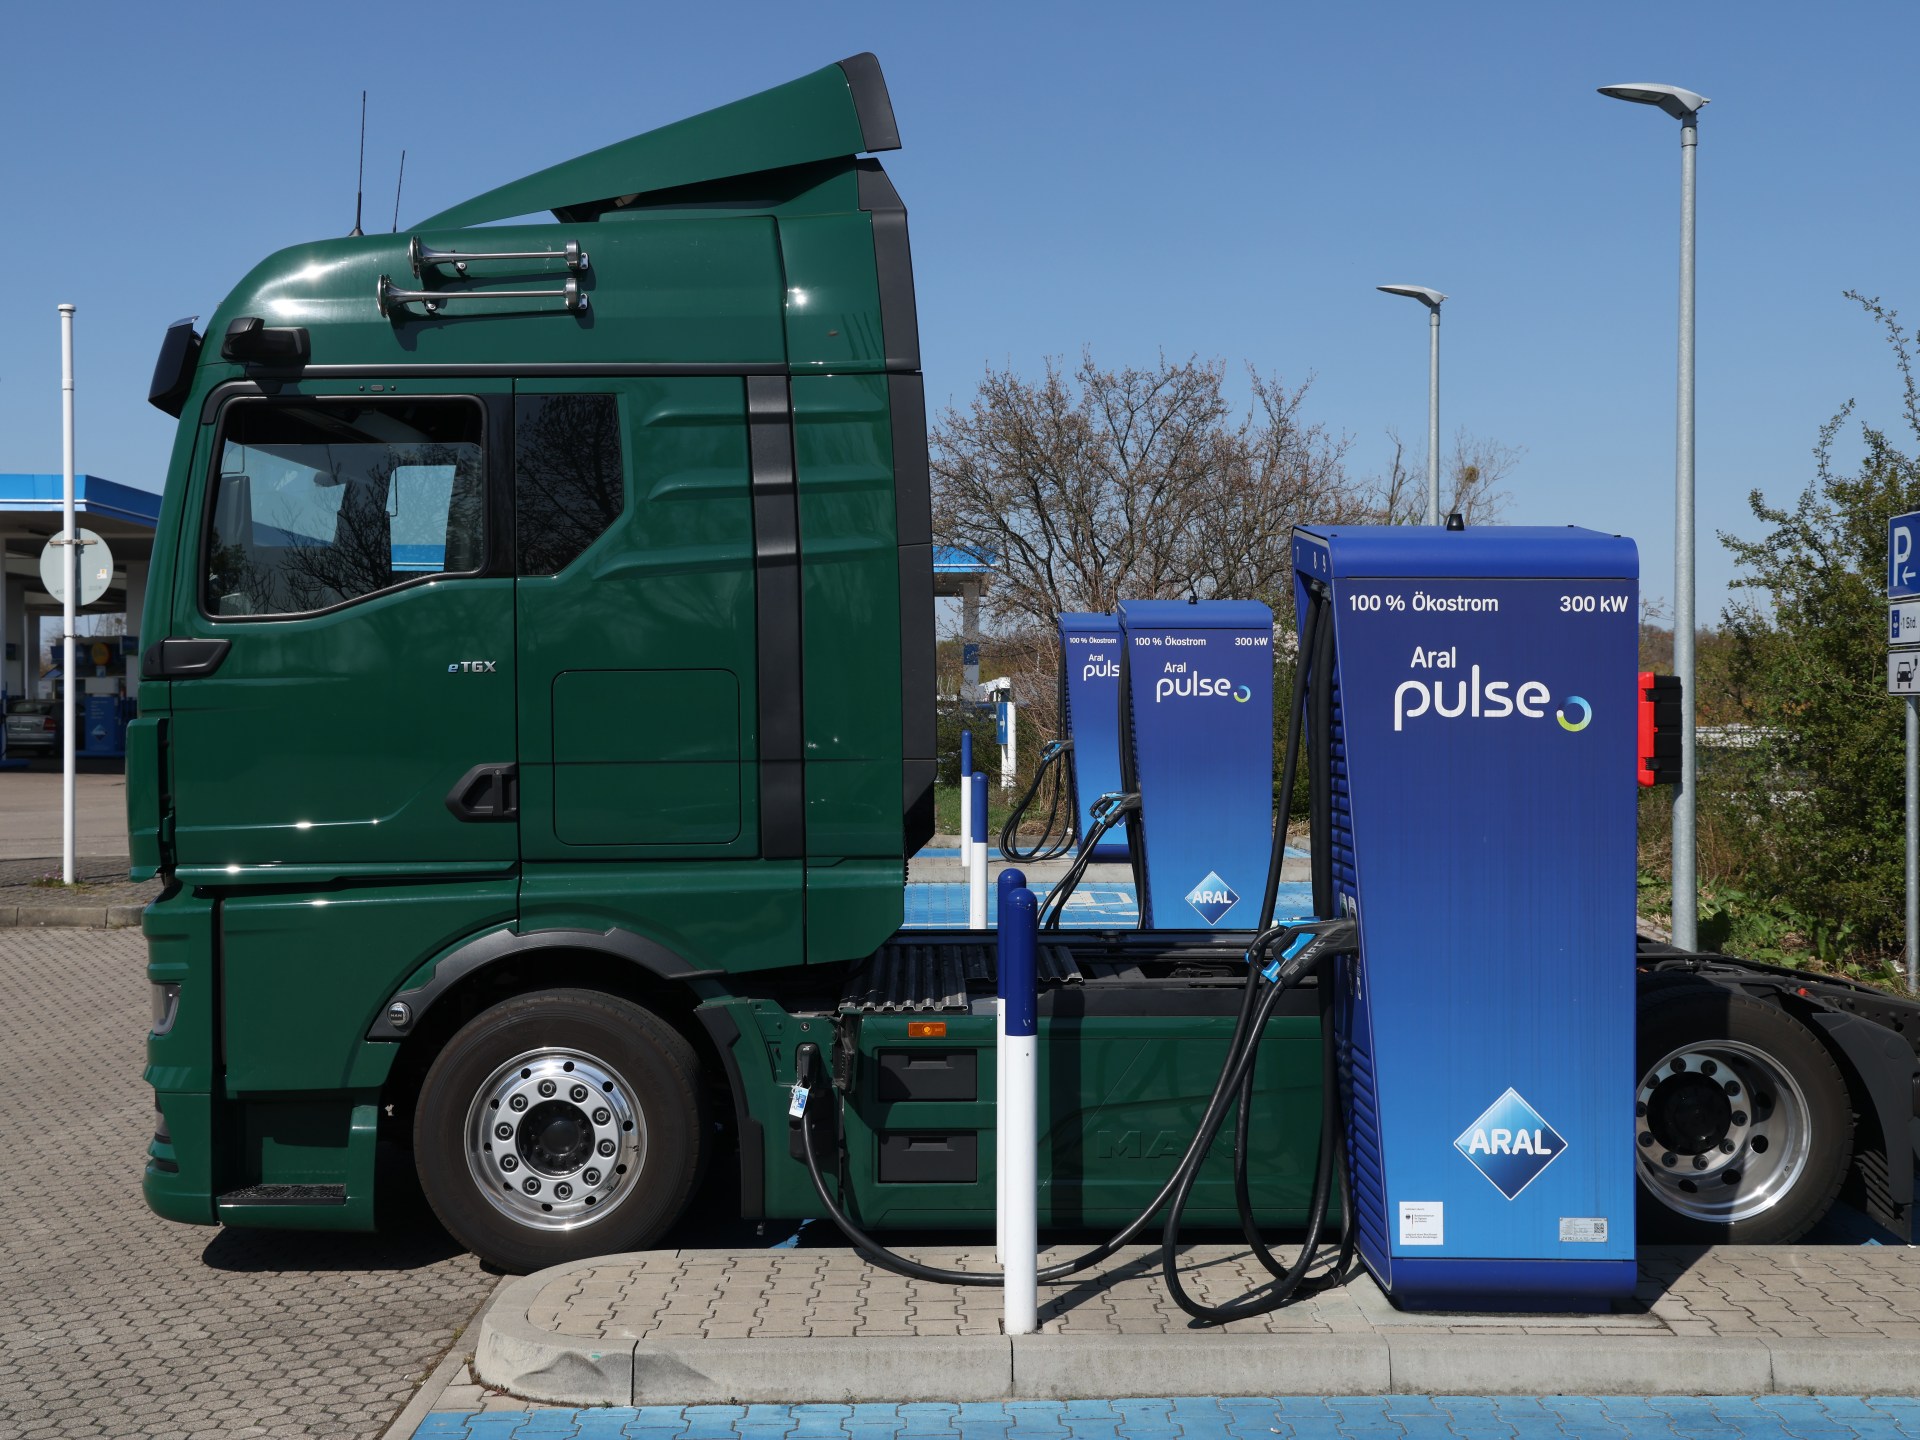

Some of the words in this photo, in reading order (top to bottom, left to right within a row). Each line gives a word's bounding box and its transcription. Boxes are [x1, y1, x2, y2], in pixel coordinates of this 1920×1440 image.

[1893, 526, 1912, 587] P
[1349, 594, 1382, 612] 100
[1385, 594, 1406, 612] %
[1412, 590, 1499, 612] Ökostrom
[1559, 595, 1596, 613] 300
[1600, 595, 1629, 613] kW
[1088, 636, 1117, 644] Ökostrom
[1134, 637, 1151, 646] 100
[1151, 637, 1163, 646] %
[1164, 635, 1207, 646] Ökostrom
[1234, 637, 1253, 646] 300
[1253, 637, 1269, 646] kW
[1088, 653, 1104, 662] Aral
[1410, 645, 1456, 668] Aral
[1083, 659, 1120, 682] puls
[1163, 661, 1187, 673] Aral
[1156, 671, 1232, 703] pulse
[1394, 664, 1551, 732] pulse
[1192, 890, 1233, 904] ARAL
[1468, 1128, 1552, 1155] ARAL
